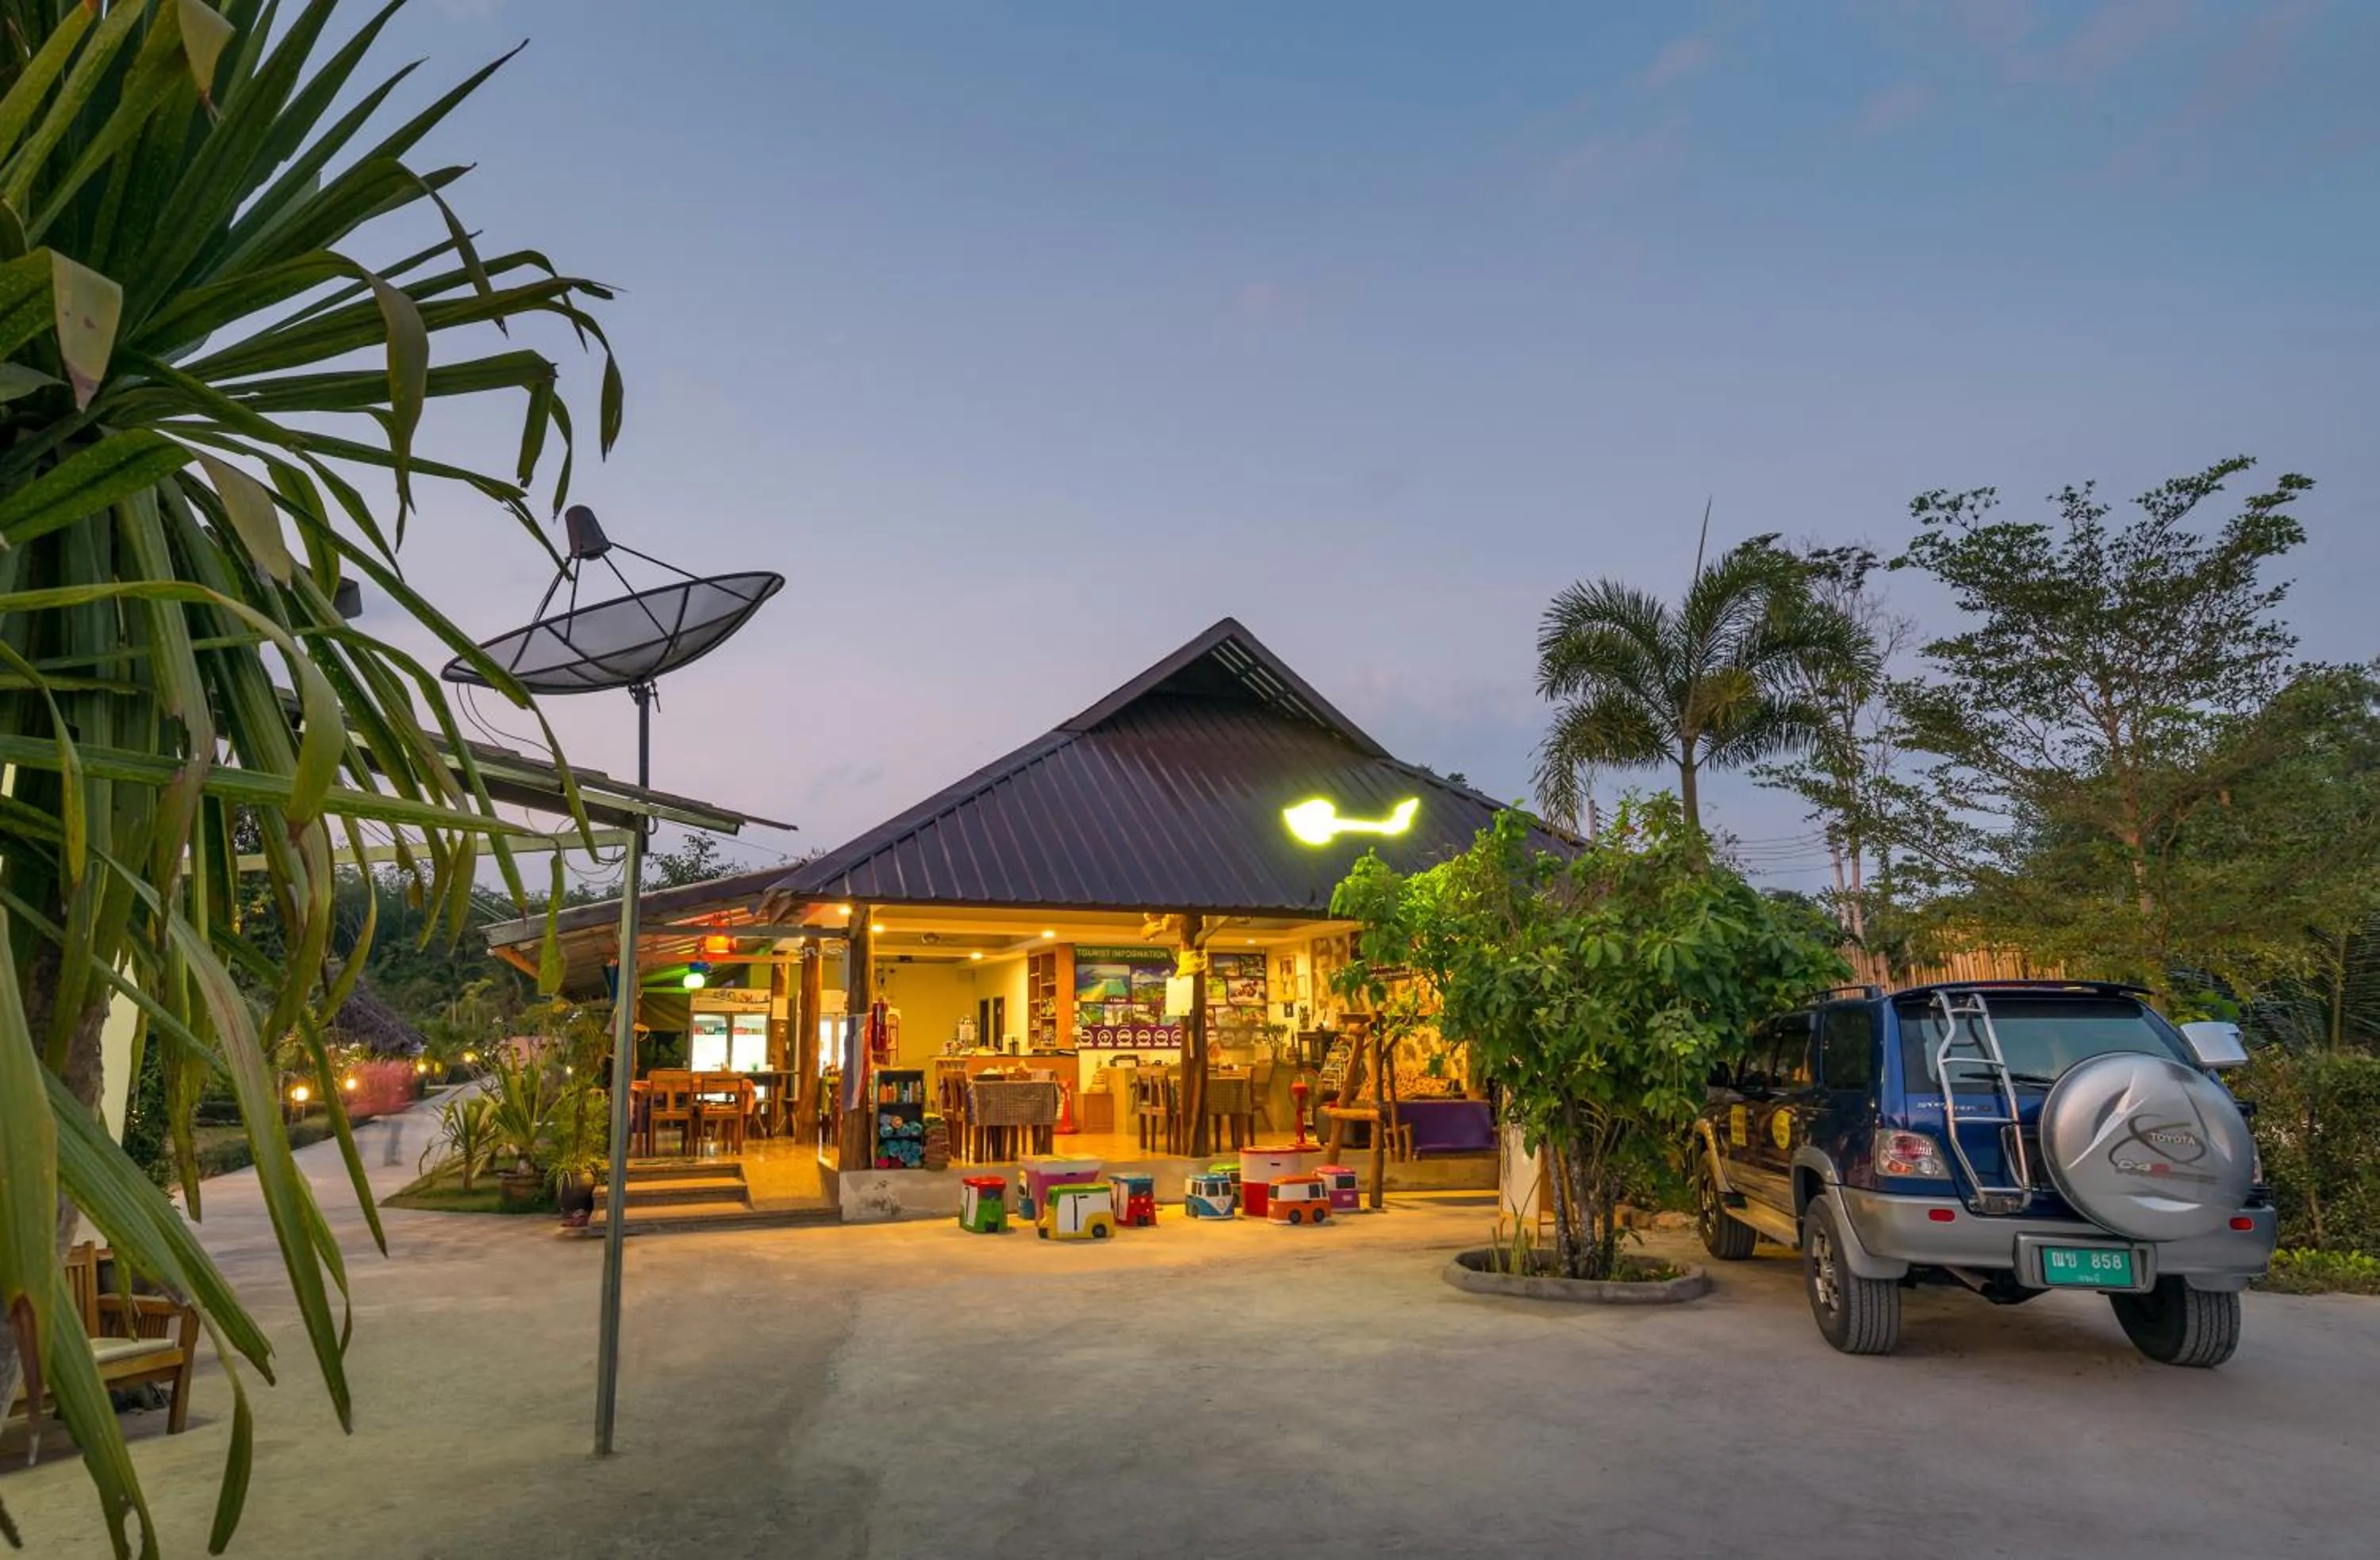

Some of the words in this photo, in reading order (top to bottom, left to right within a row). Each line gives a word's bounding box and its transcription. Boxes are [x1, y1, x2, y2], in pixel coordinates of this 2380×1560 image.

[1077, 948, 1110, 957] TOURIST
[1111, 949, 1167, 959] INFORMATION
[2150, 1132, 2196, 1145] TOYOTA
[2091, 1254, 2122, 1270] 858
